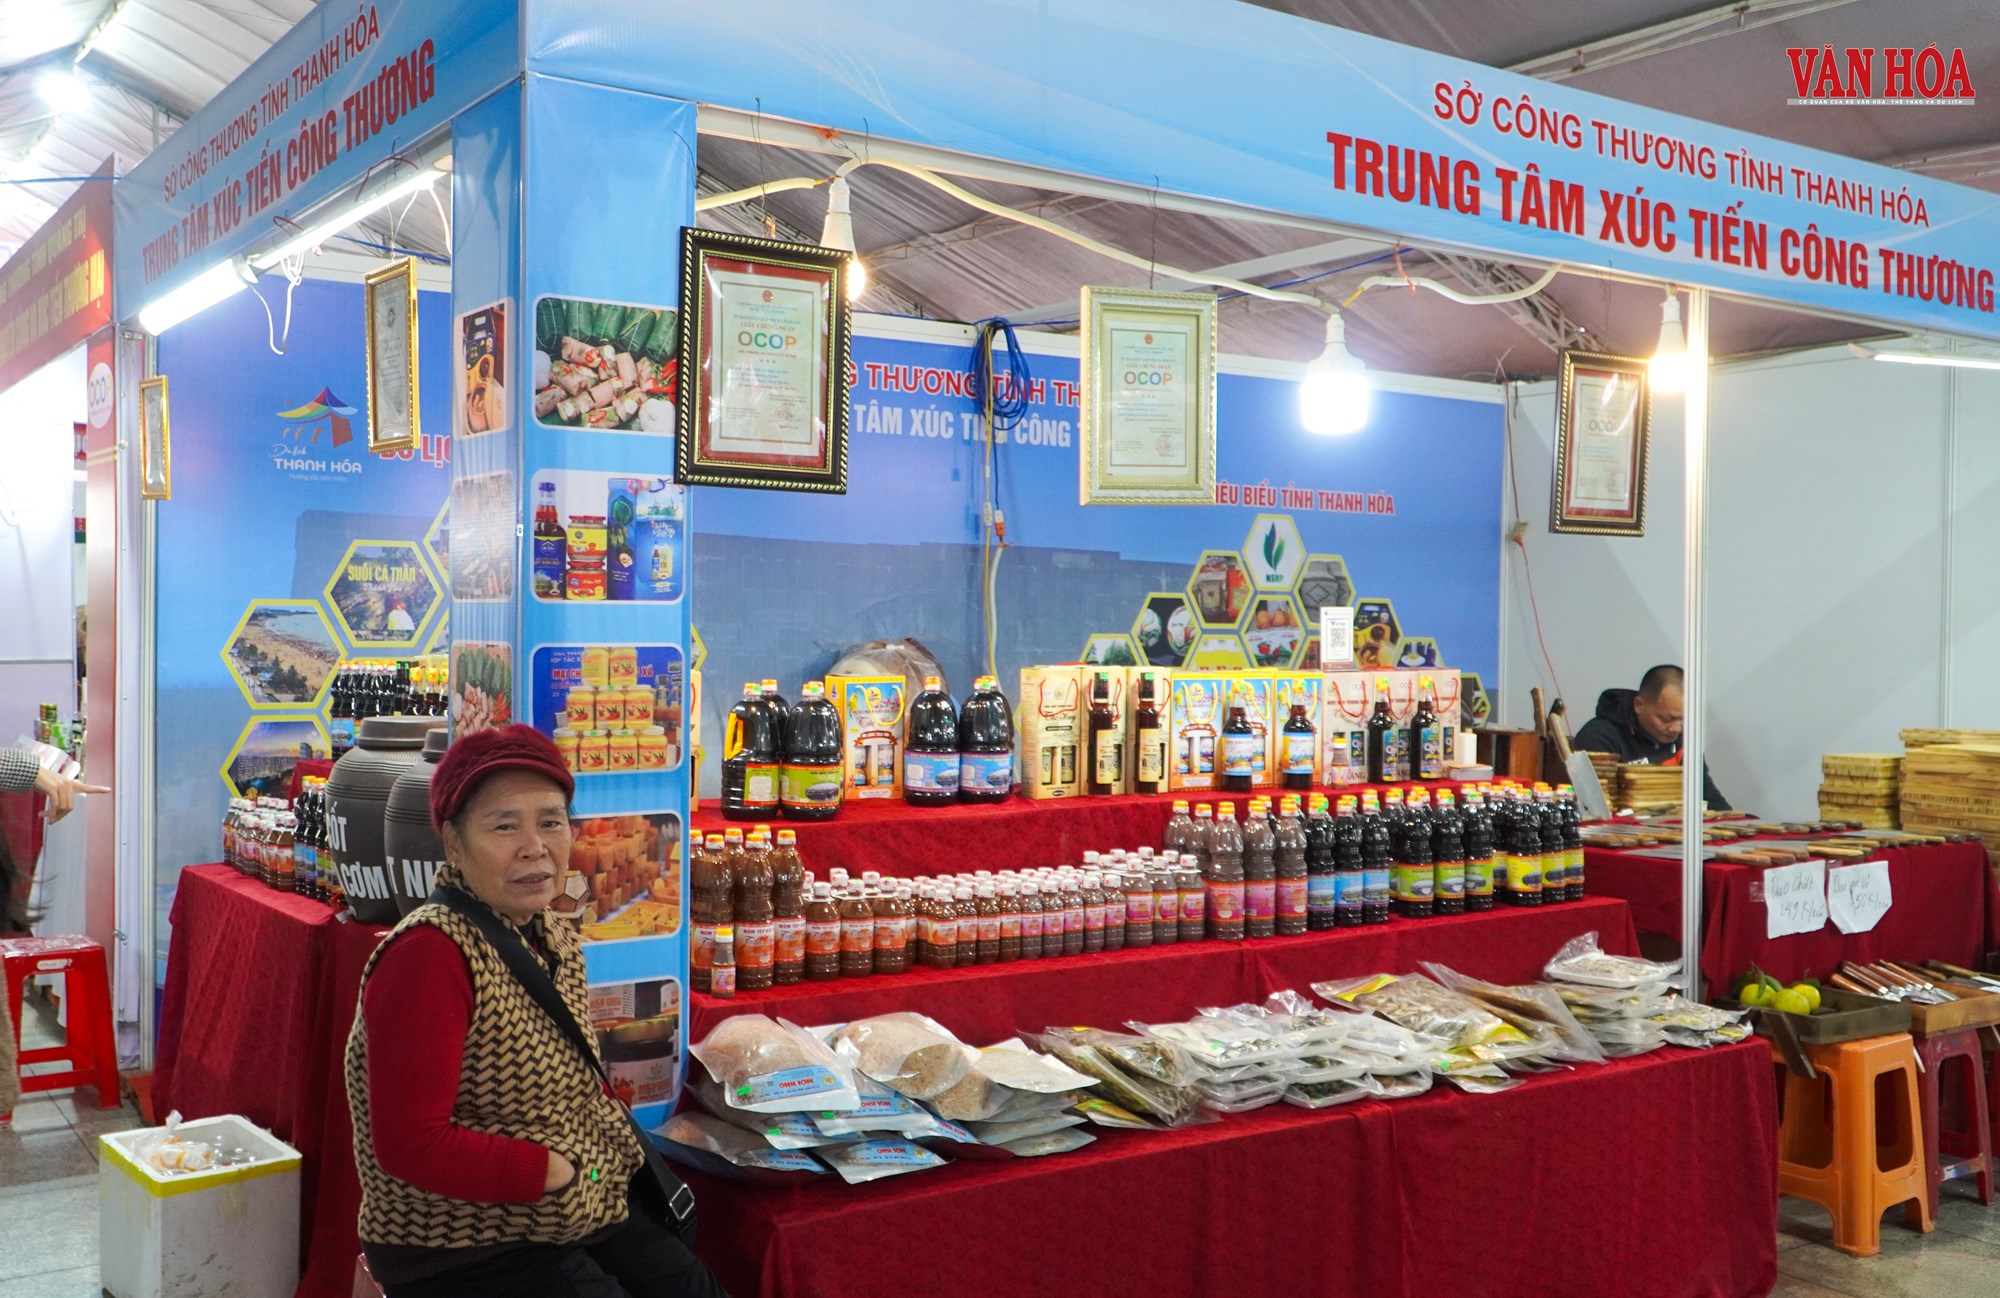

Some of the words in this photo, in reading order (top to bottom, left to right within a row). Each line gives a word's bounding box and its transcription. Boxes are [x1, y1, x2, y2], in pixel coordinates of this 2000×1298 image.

[164, 170, 178, 203] SỞ
[180, 147, 207, 191] CÔNG
[209, 104, 258, 168] THƯƠNG
[260, 78, 289, 128] TỈNH
[292, 35, 339, 102] THANH
[344, 5, 380, 62] HÓA
[142, 224, 178, 285] TRUNG
[182, 202, 209, 260] TÂM
[213, 177, 241, 240] XÚC
[246, 139, 282, 218] TIẾN
[287, 109, 337, 191] CÔNG
[343, 38, 435, 153] THƯƠNG
[1434, 80, 1483, 125] SỞ
[1492, 94, 1583, 150] CÔNG
[1591, 120, 1717, 180] THƯƠNG
[1724, 148, 1783, 195] TỈNH
[1790, 168, 1874, 216] THANH
[1881, 186, 1930, 228] HÓA
[1326, 131, 1481, 216] TRUNG
[1495, 162, 1585, 236] TÂM
[1599, 186, 1676, 253] XÚC
[1688, 201, 1768, 271] TIẾN
[1780, 223, 1868, 289] CÔNG
[1878, 247, 1994, 313] THƯƠNG
[738, 330, 797, 350] OCOP
[1124, 370, 1173, 386] OCOP
[853, 399, 902, 435] TÂM
[909, 404, 954, 439] XÚC
[1014, 412, 1071, 447] CÔNG
[273, 458, 326, 472] THANH
[330, 459, 362, 474] HÓA
[421, 433, 450, 468] LỊ
[1215, 482, 1239, 505] IÊU
[1243, 480, 1277, 508] BIỂU
[1280, 481, 1314, 510] TỈNH
[1318, 488, 1363, 514] THANH
[1367, 490, 1396, 515] HÓA
[374, 563, 388, 581] CÁ
[340, 860, 390, 900] CƠM
